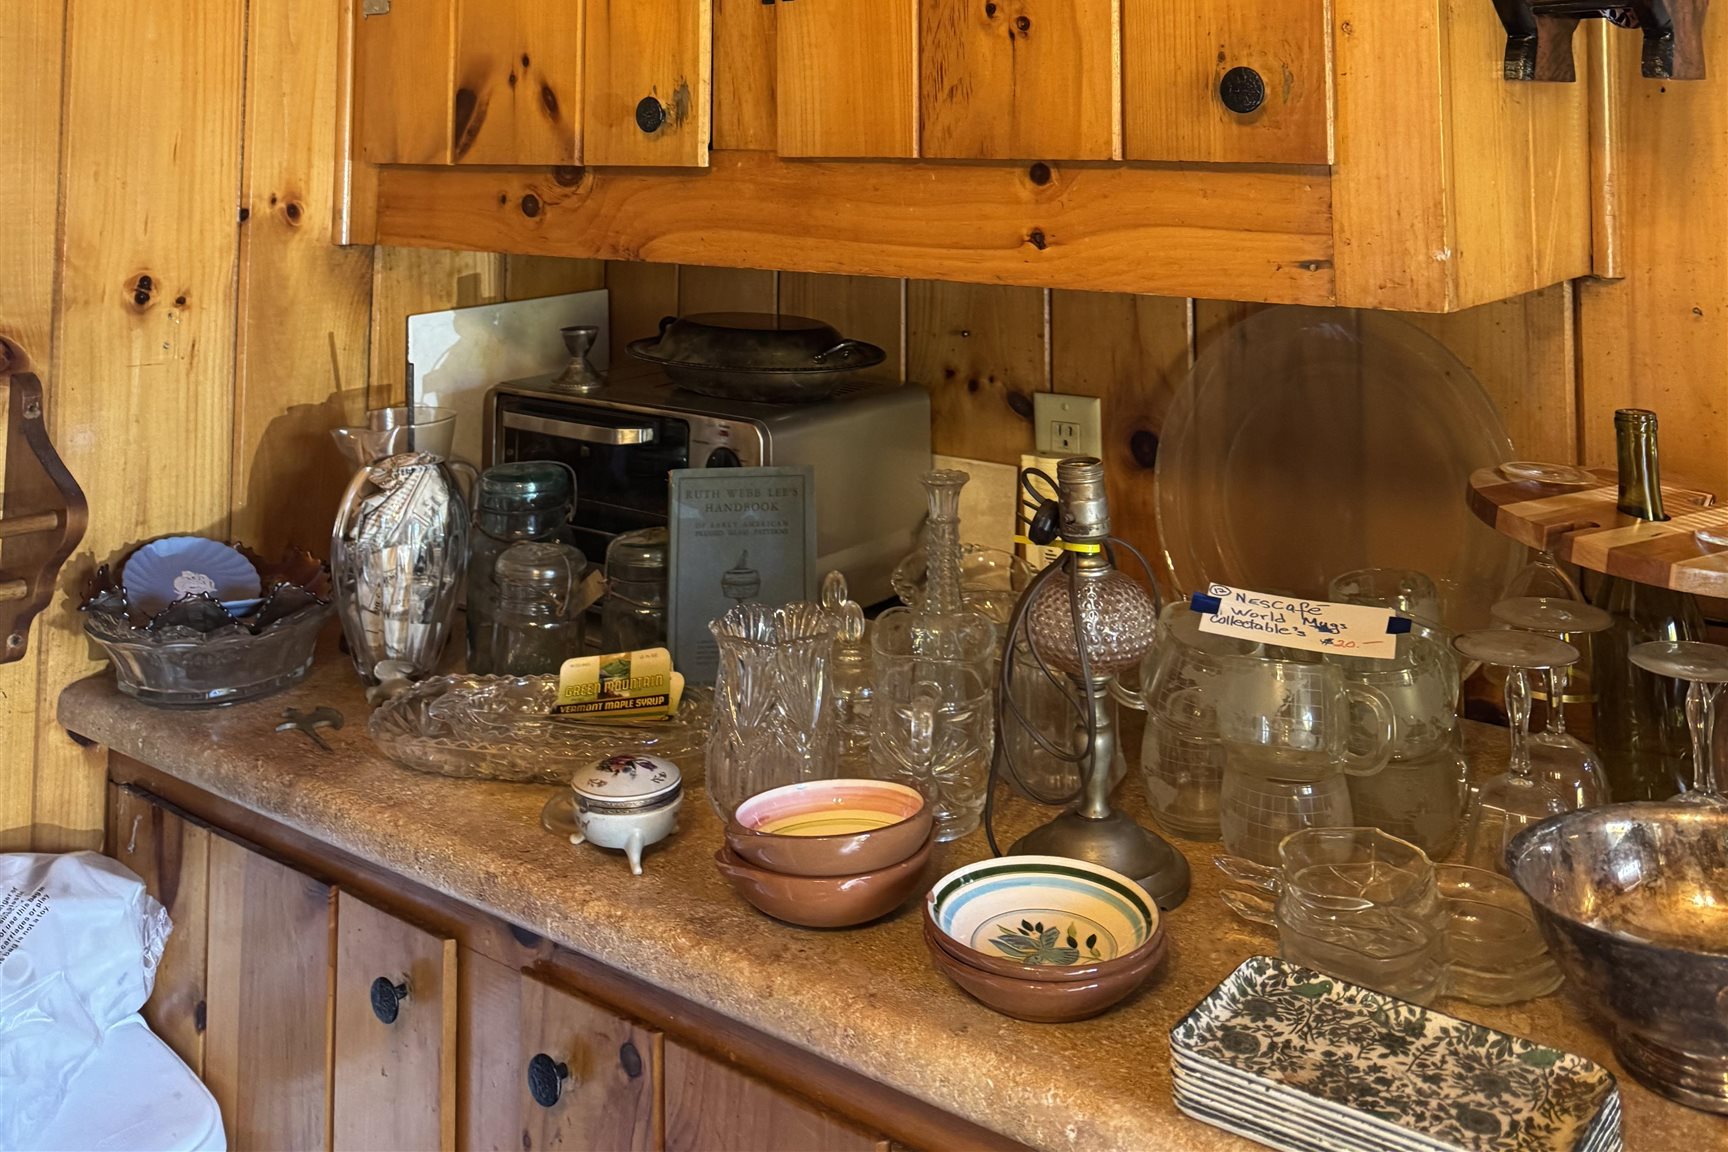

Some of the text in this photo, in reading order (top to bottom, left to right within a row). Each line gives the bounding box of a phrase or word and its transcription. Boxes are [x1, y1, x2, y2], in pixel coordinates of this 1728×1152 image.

[705, 502, 779, 513] HANDBOOK
[1231, 606, 1348, 634] World Mugs
[565, 674, 664, 697] GREEN MOUNTAIN
[560, 702, 603, 713] VERMONT
[604, 699, 634, 710] MAPLE
[635, 696, 665, 708] SYRUP
